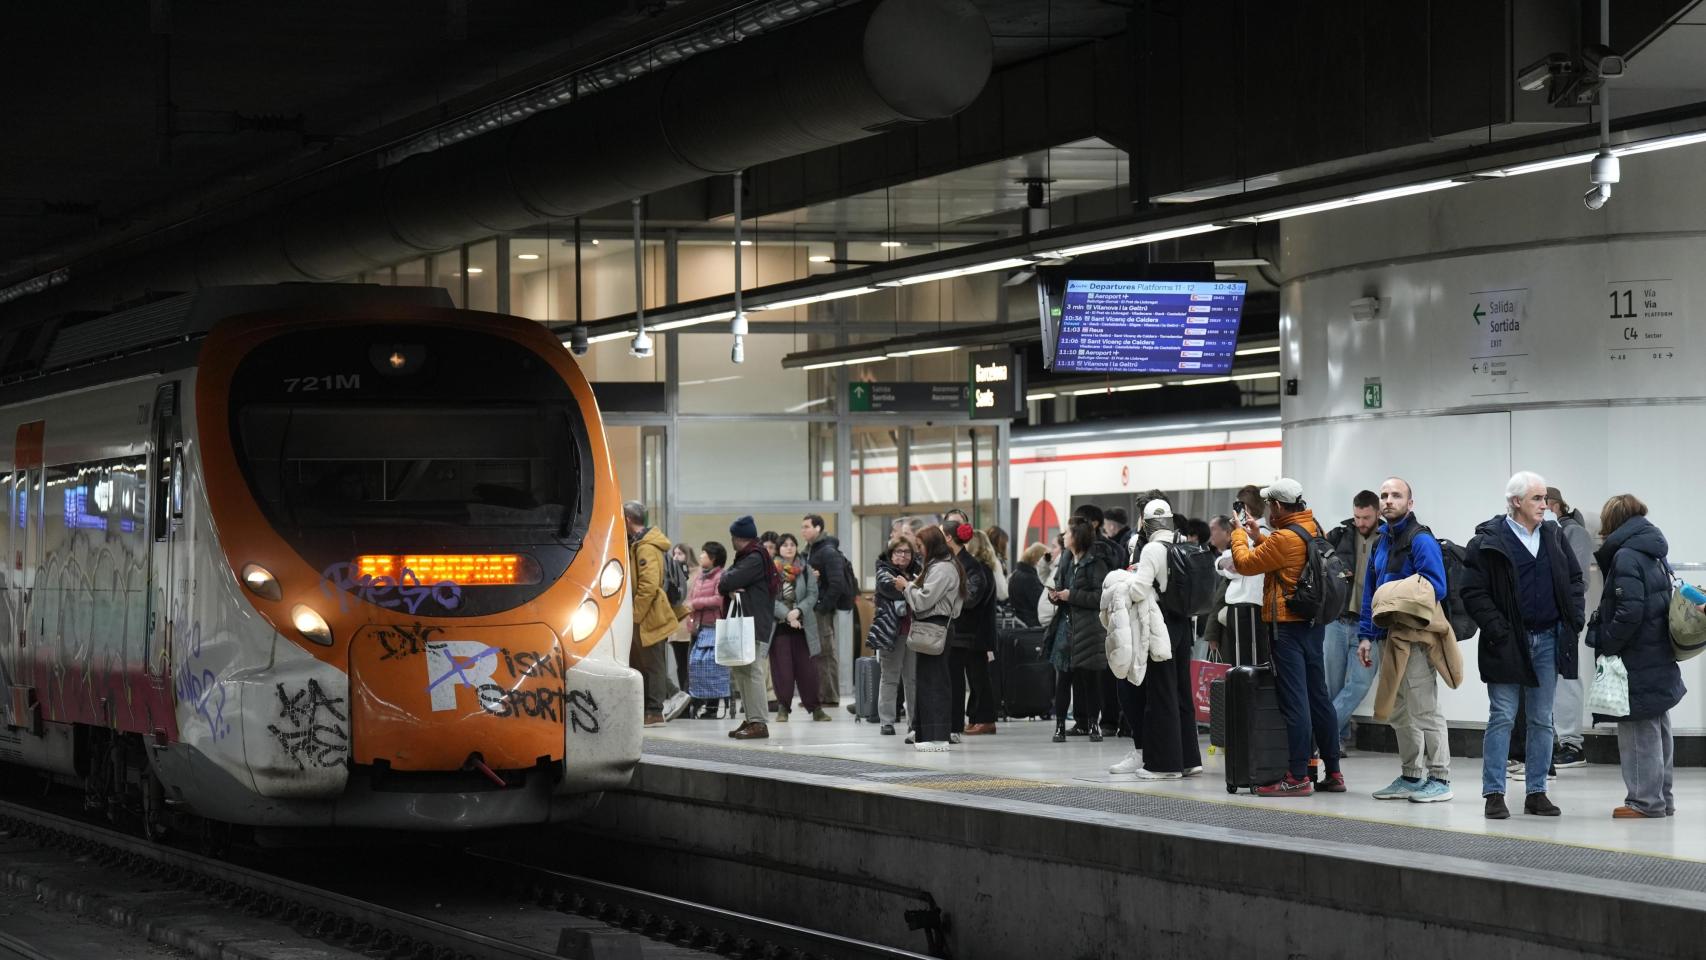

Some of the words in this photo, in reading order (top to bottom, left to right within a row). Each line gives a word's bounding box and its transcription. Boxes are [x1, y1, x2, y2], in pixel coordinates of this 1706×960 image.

[1089, 283, 1136, 291] Departures
[1137, 283, 1174, 291] Platforms
[1214, 283, 1237, 291] 10:43
[1490, 300, 1514, 314] Salida
[1609, 289, 1638, 319] 11
[1490, 318, 1520, 333] Sortida
[1624, 327, 1638, 341] C4
[284, 374, 361, 393] 721M
[426, 640, 499, 712] R
